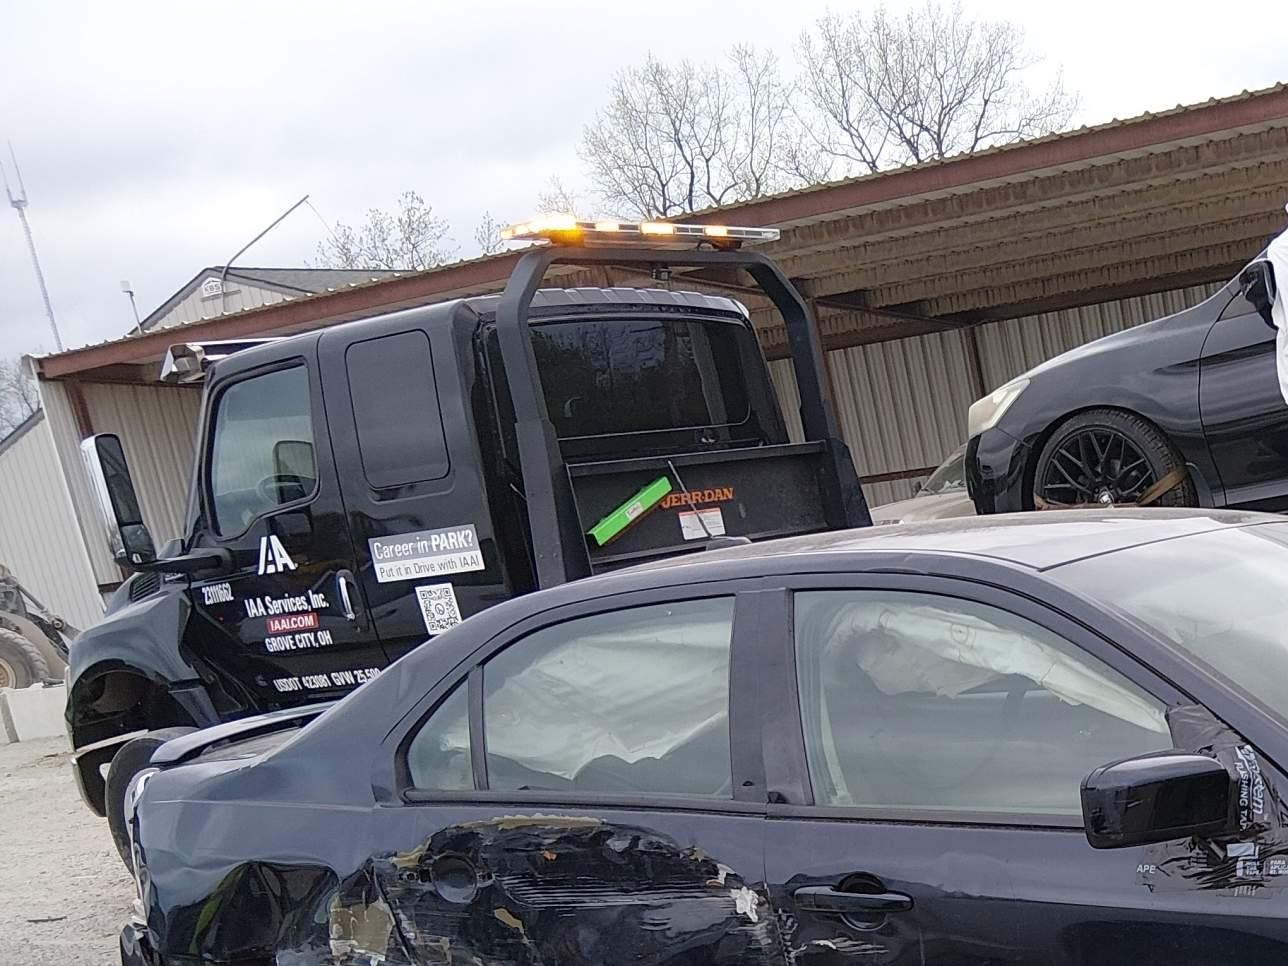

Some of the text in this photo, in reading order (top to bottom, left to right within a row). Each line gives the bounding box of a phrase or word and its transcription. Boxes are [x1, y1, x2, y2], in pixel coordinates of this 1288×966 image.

[373, 529, 473, 560] Career in PARK?
[379, 566, 395, 579] Put
[413, 562, 436, 575] Drive
[438, 557, 457, 571] with
[244, 589, 329, 618] IAA Services, Inc.
[265, 630, 333, 653] GROVE CITY, OH
[273, 677, 302, 692] USDOT
[331, 671, 355, 686] GVW
[1239, 809, 1249, 832] TAP
